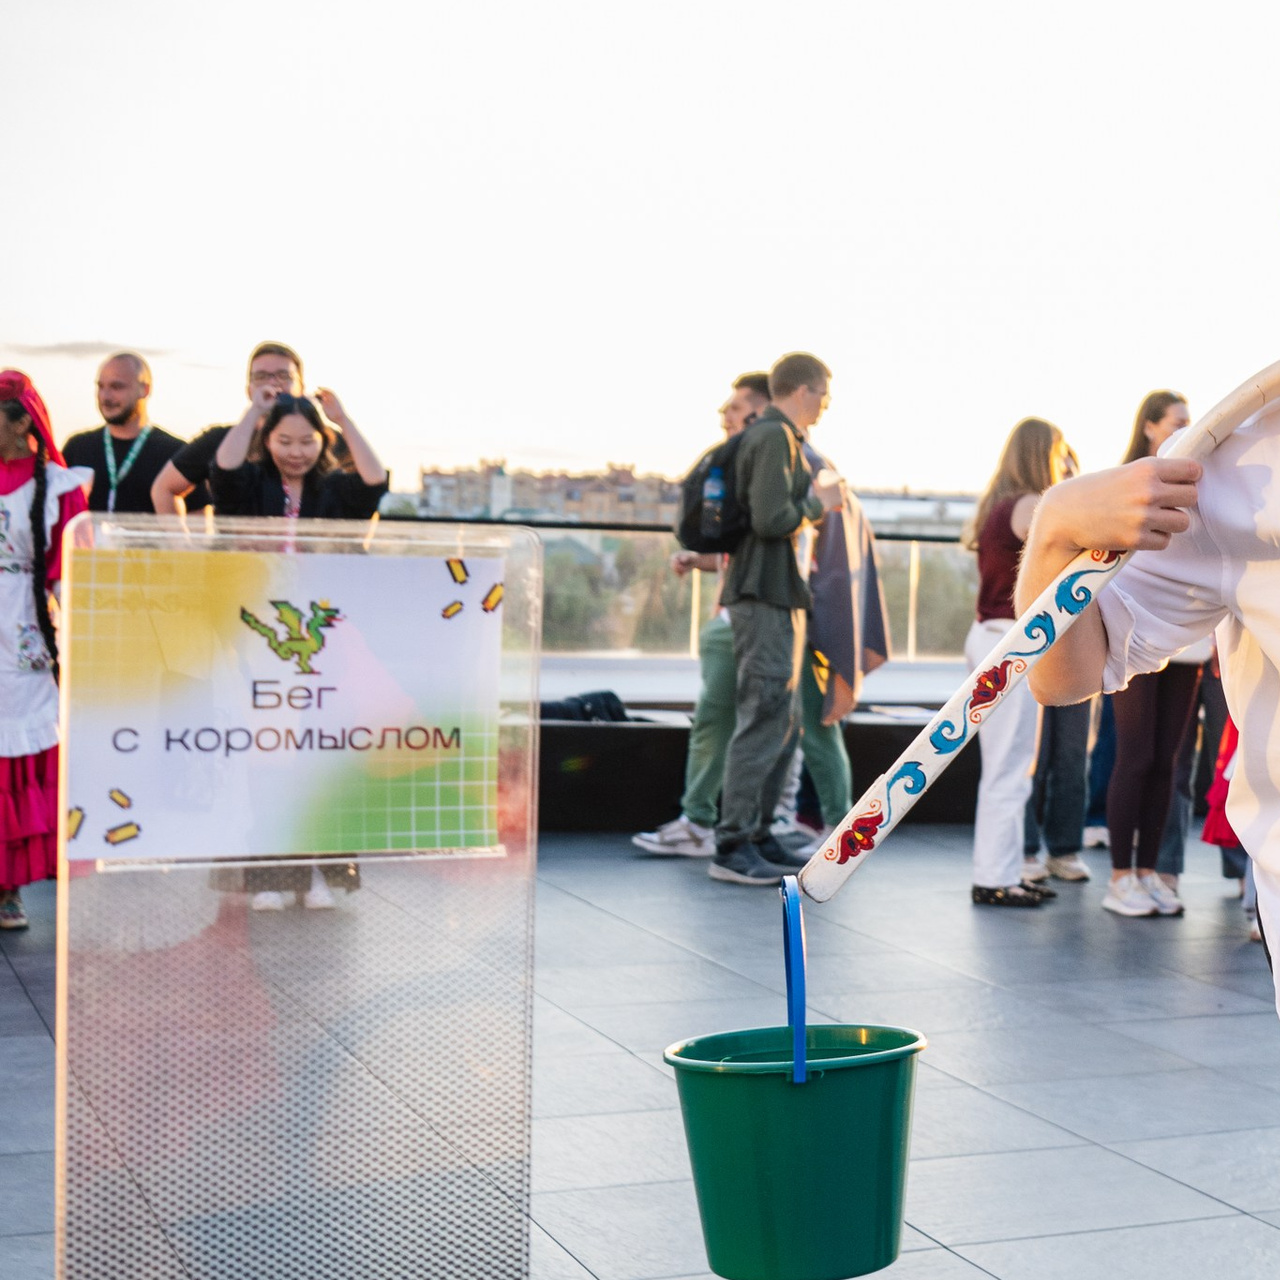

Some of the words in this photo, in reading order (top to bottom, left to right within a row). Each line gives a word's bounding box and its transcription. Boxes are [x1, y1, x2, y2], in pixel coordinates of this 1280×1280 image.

[252, 679, 337, 710] Бег
[112, 727, 140, 753] с
[165, 726, 461, 757] коромыслом
